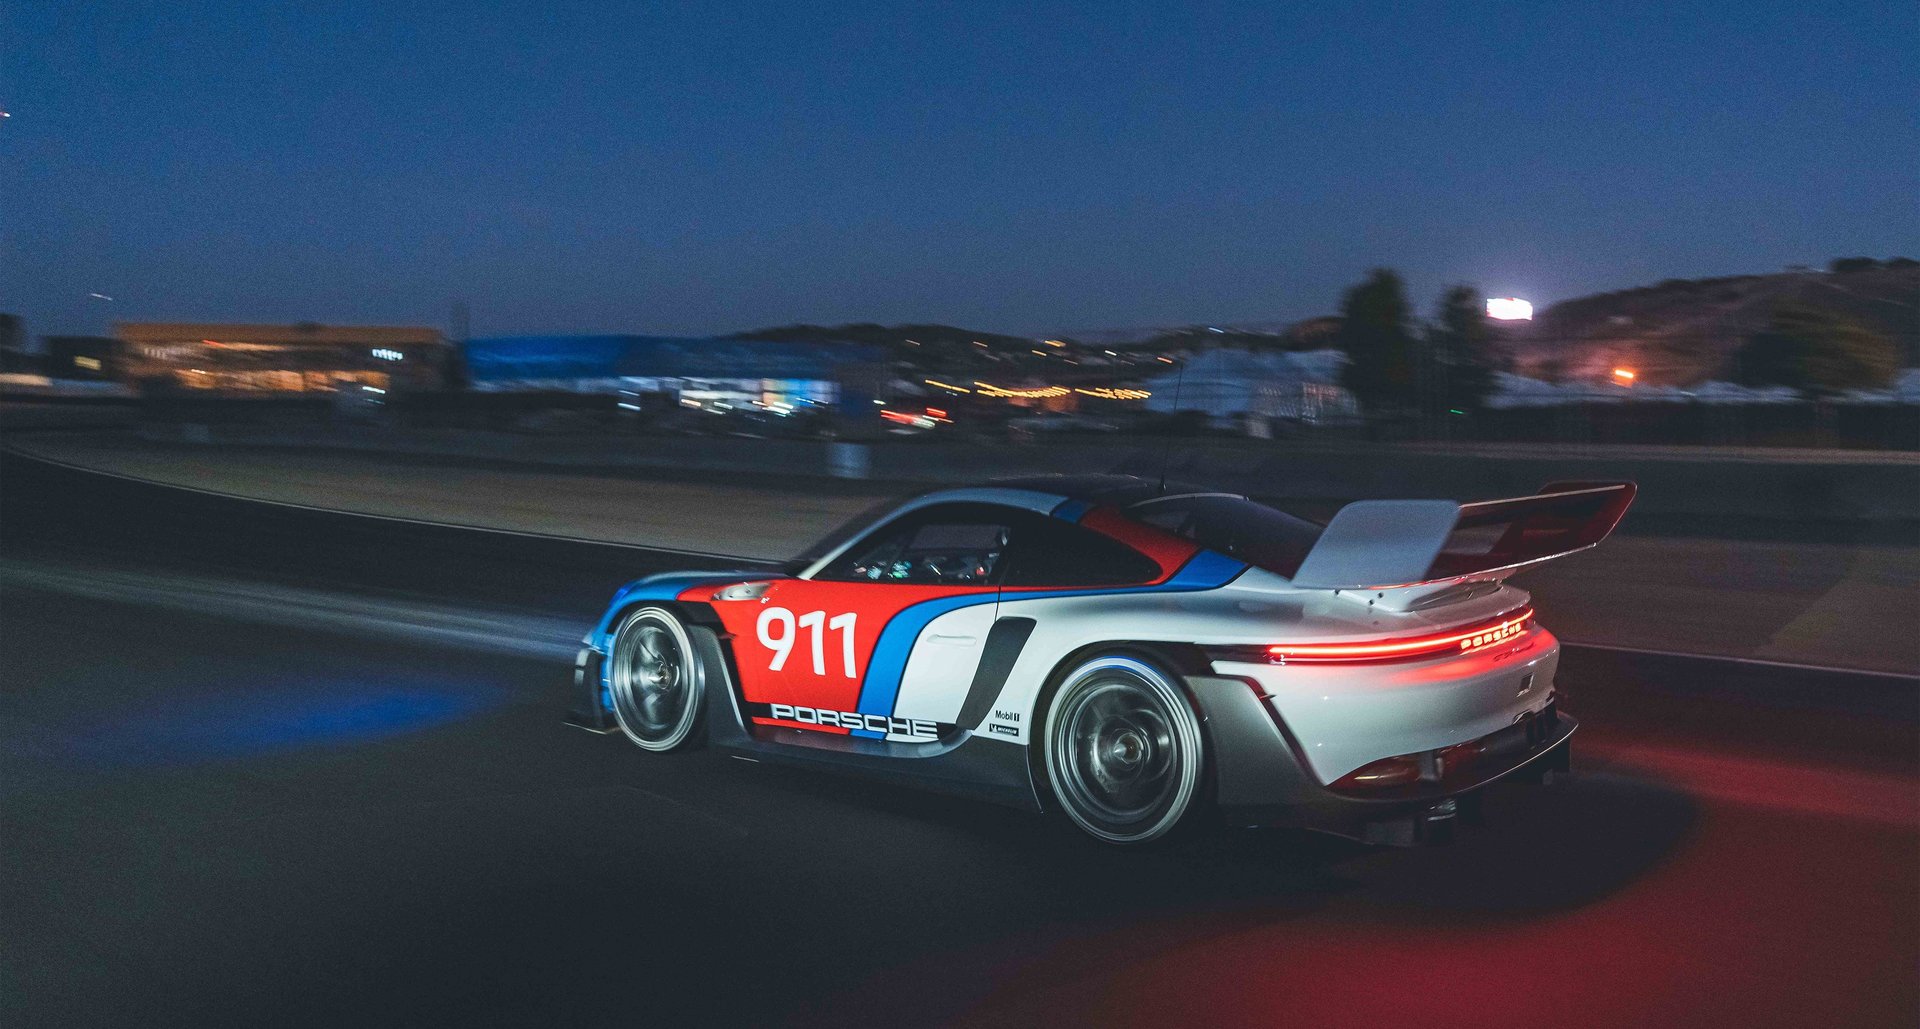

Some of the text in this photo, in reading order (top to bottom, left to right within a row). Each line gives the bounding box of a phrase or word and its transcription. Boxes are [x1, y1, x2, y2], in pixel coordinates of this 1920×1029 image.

[756, 606, 857, 678] 911
[1460, 622, 1521, 649] PORSCHE
[771, 703, 938, 738] PORSCHE
